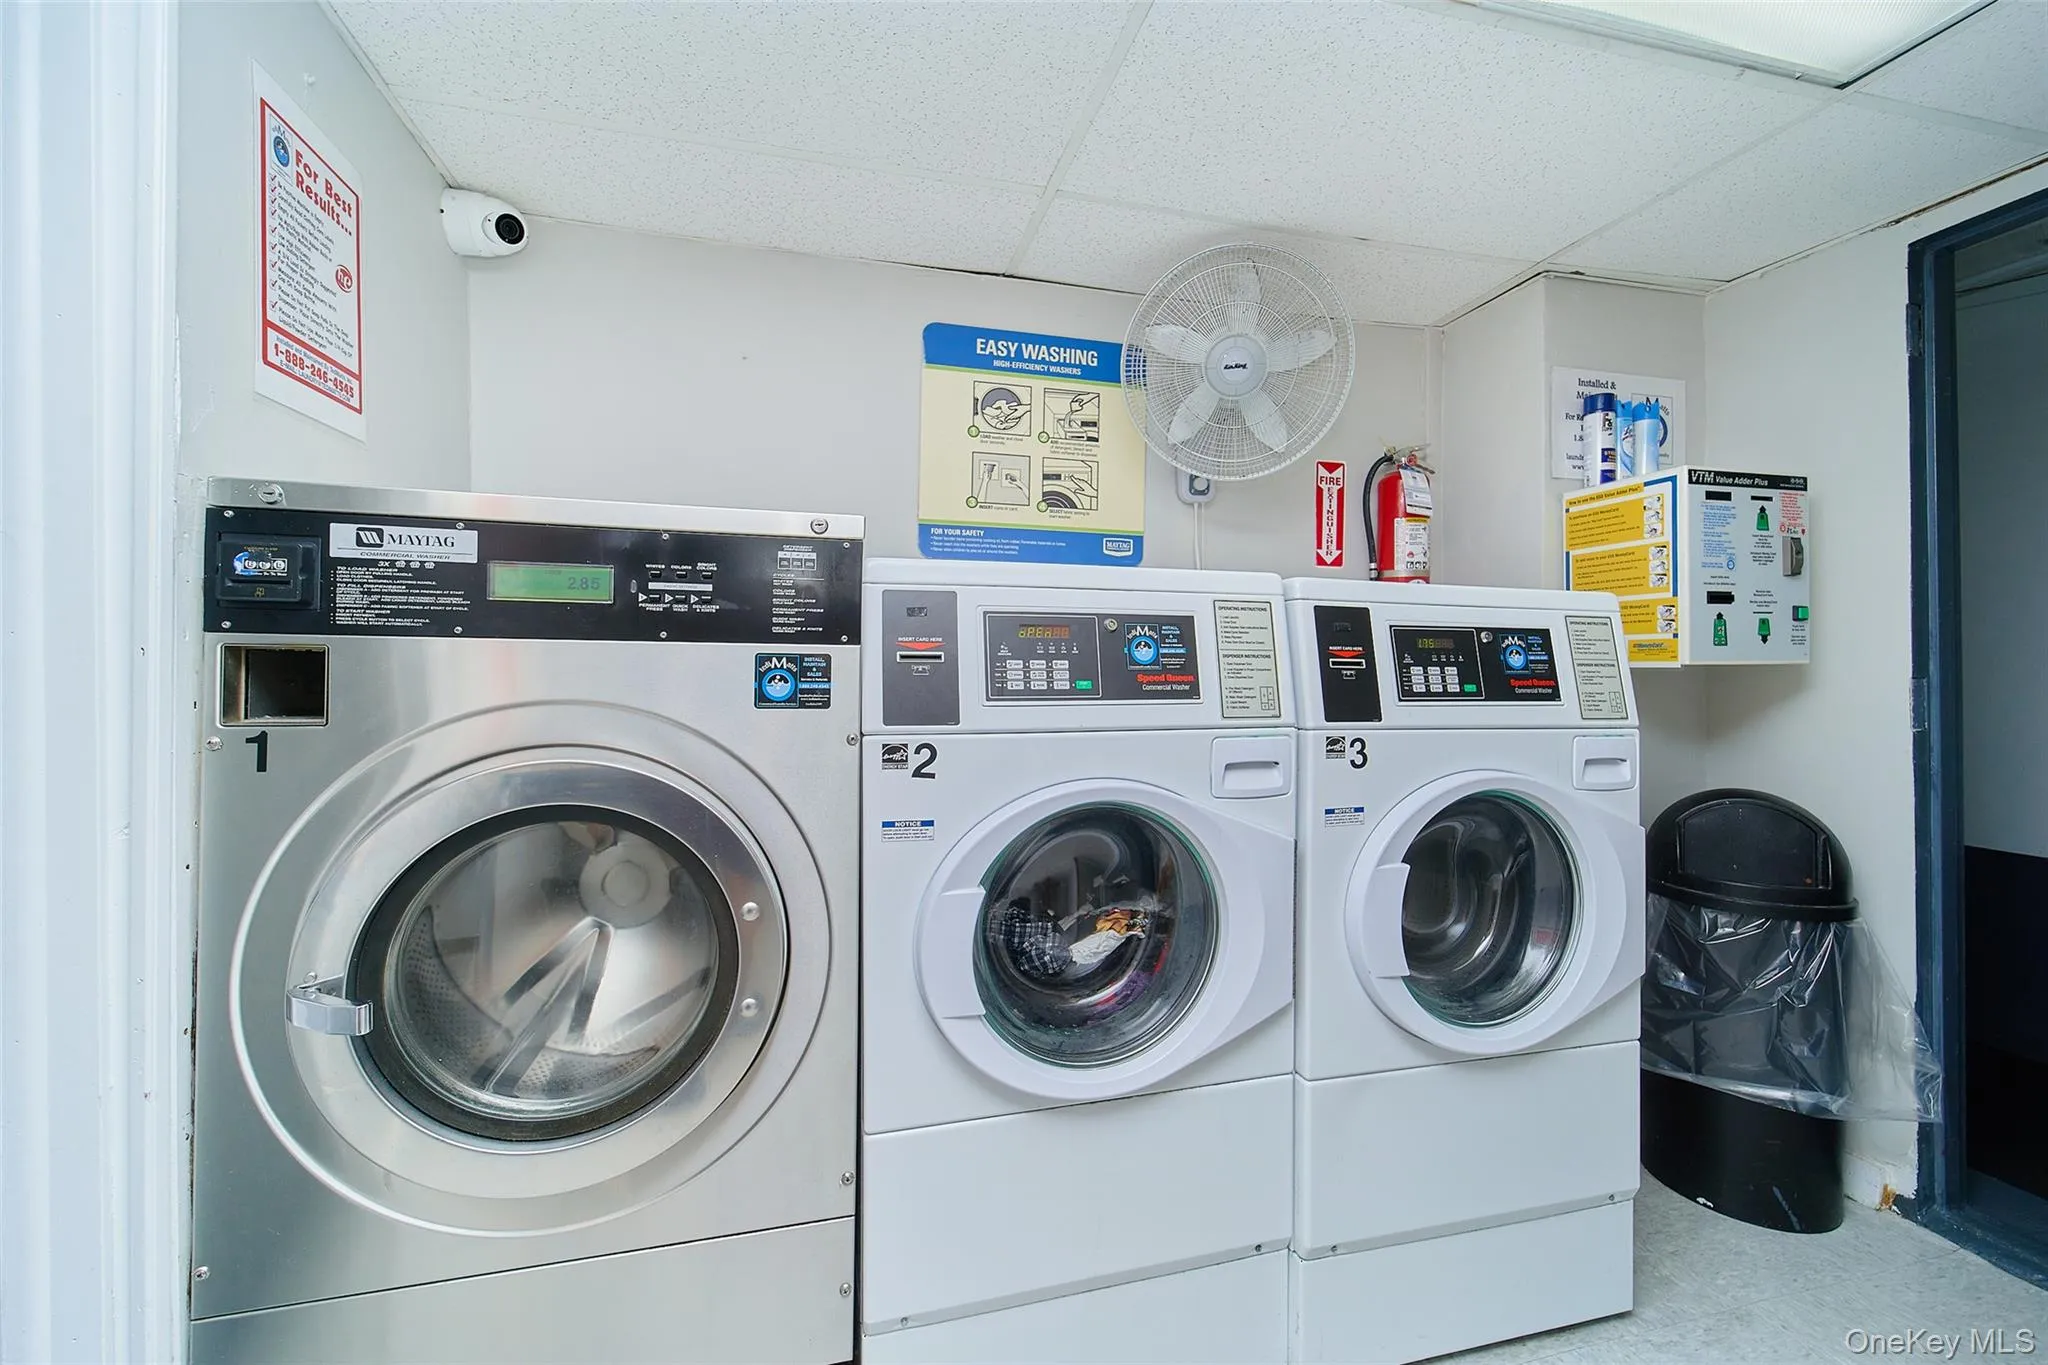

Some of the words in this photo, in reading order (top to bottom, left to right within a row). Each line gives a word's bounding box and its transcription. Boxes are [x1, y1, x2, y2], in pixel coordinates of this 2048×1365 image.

[296, 150, 318, 184] For
[324, 178, 352, 218] Best
[296, 170, 352, 236] Results...
[976, 338, 1018, 358] EASY
[1024, 343, 1098, 366] WASHING
[993, 359, 1048, 372] HIGH-EFFICIENCY
[1049, 365, 1082, 376] WASHERS
[1578, 378, 1608, 389] Installed
[1610, 381, 1616, 390] &
[1320, 476, 1341, 486] FIRE
[1691, 470, 1714, 483] VTM
[1715, 476, 1732, 484] Value
[1733, 477, 1753, 485] Adder
[1754, 478, 1768, 486] Plus
[1326, 487, 1334, 556] EXTINGUISHER
[944, 528, 960, 536] YOUR
[388, 534, 456, 548] MAYTAG
[1106, 541, 1131, 550] MAYTAG
[566, 576, 600, 590] 2.85
[1137, 674, 1165, 683] Speed
[1166, 674, 1194, 682] Queen
[1511, 679, 1532, 687] Speed
[246, 730, 268, 772] 1
[1350, 738, 1368, 769] 3
[912, 743, 938, 779] 2
